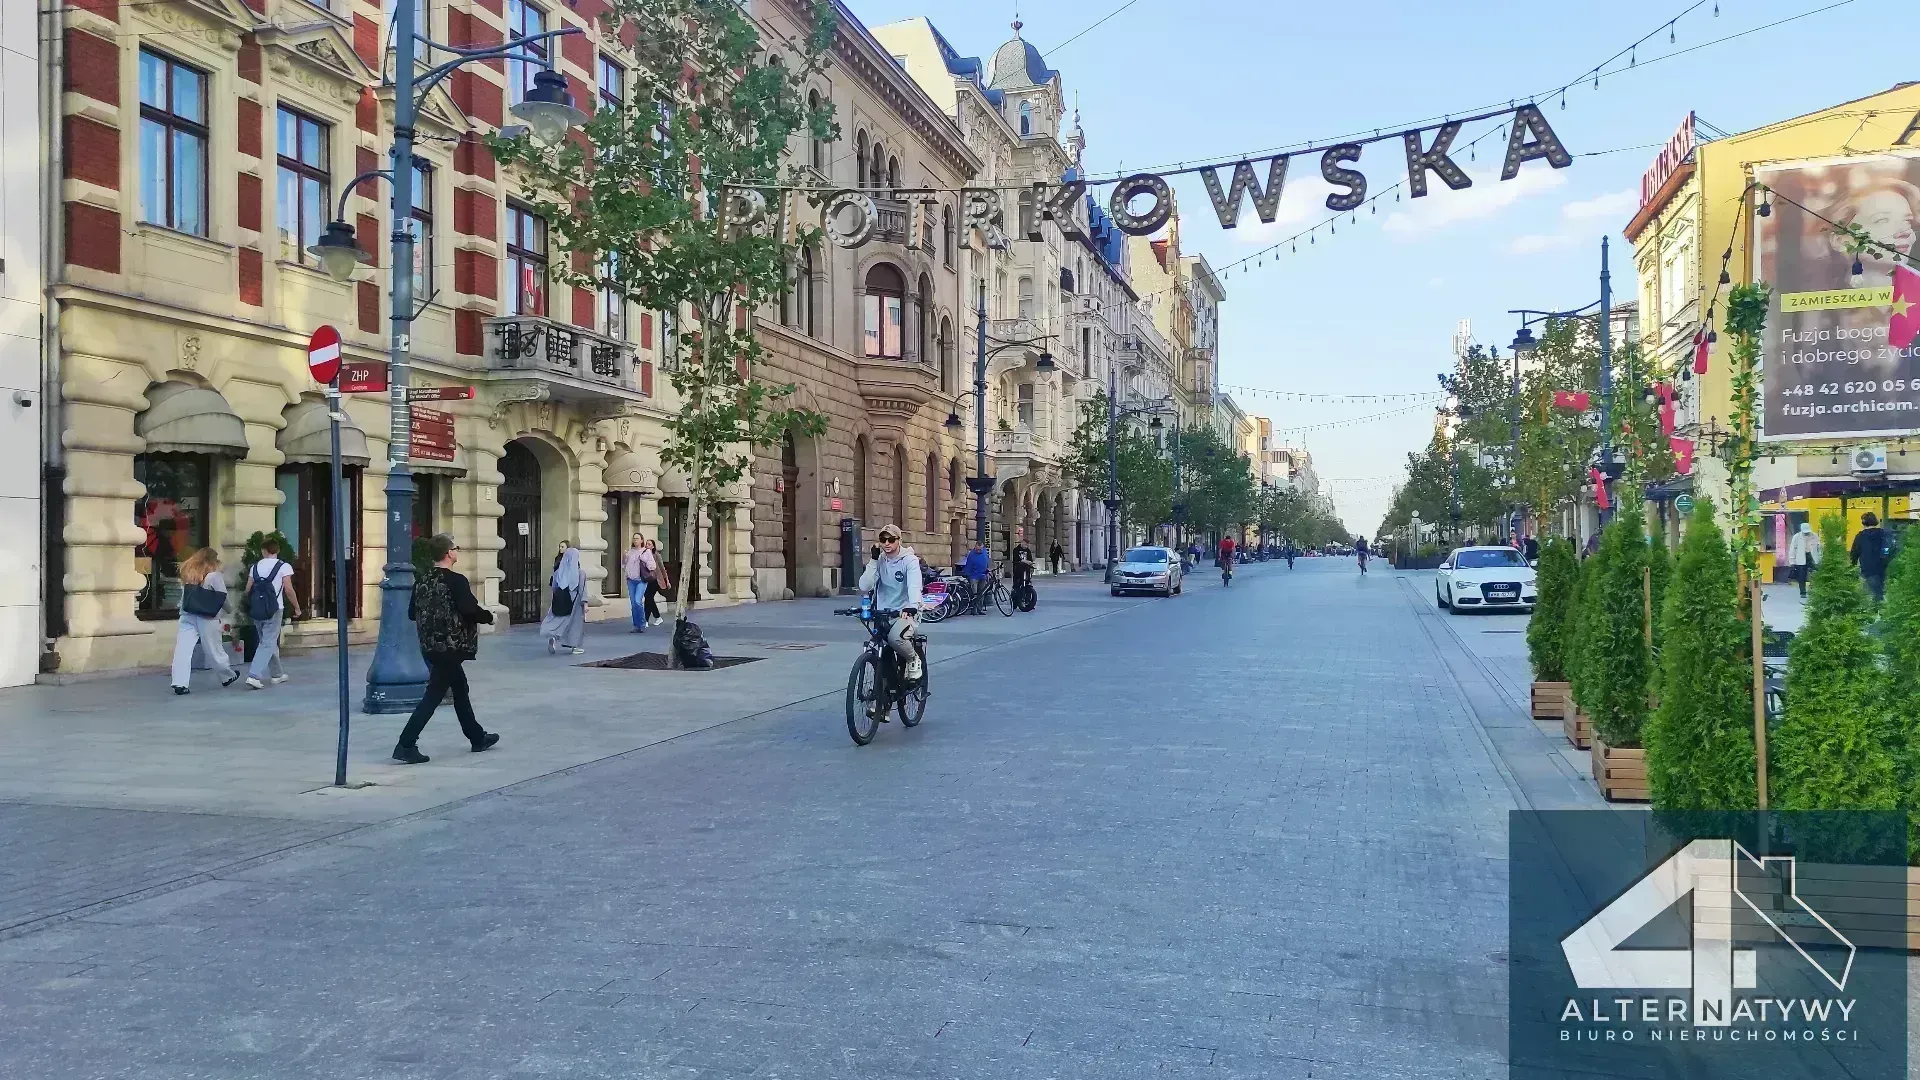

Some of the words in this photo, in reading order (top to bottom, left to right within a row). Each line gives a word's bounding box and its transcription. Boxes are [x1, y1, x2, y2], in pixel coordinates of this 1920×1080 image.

[717, 102, 1572, 250] PIOTRKOWSKA
[1791, 292, 1873, 307] ZAMIESZKAJ
[1878, 291, 1892, 301] W
[1782, 327, 1830, 346] Fuzja
[1836, 325, 1890, 342] boga
[1781, 350, 1787, 365] i
[1791, 347, 1872, 365] dobrego
[351, 369, 370, 382] ZHP
[1782, 384, 1814, 398] +48
[1818, 382, 1839, 395] 42
[1844, 381, 1877, 394] 620
[1882, 379, 1906, 392] 05
